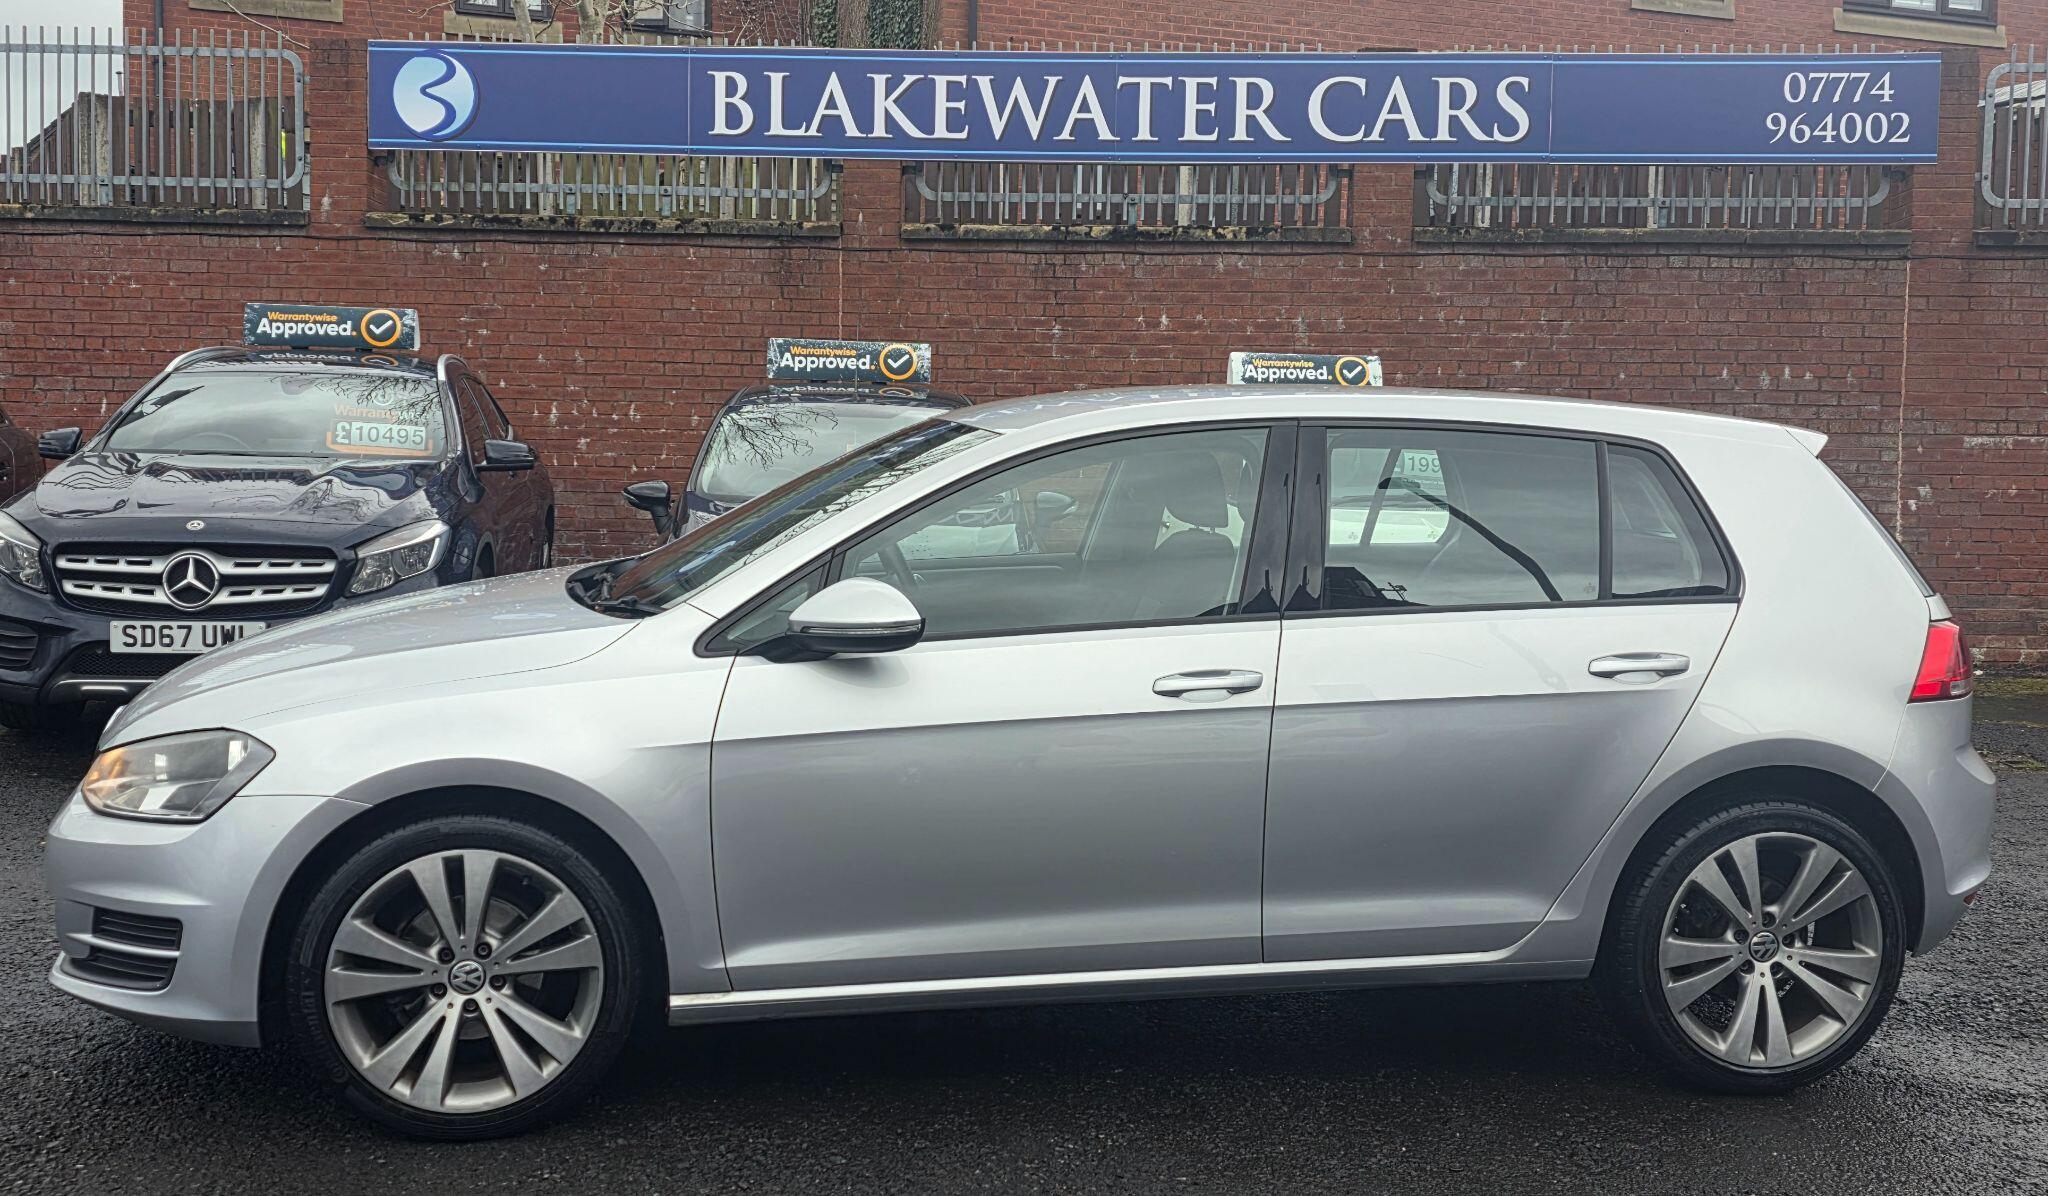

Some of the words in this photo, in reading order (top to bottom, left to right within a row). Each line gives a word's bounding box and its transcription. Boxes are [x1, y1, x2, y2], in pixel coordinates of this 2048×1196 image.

[1783, 71, 1894, 105] 07774
[708, 70, 1290, 142] BLAKEWATER
[1307, 75, 1532, 144] CARS
[1766, 111, 1911, 144] 964002
[256, 317, 357, 338] Approved.
[267, 311, 338, 323] Warrantywise
[790, 345, 857, 357] Warrantywise
[780, 352, 876, 372] Approved.
[1252, 358, 1315, 369] Warrantywise
[1244, 365, 1333, 382] Approved.
[335, 421, 424, 445] £10495
[121, 624, 193, 648] SD67
